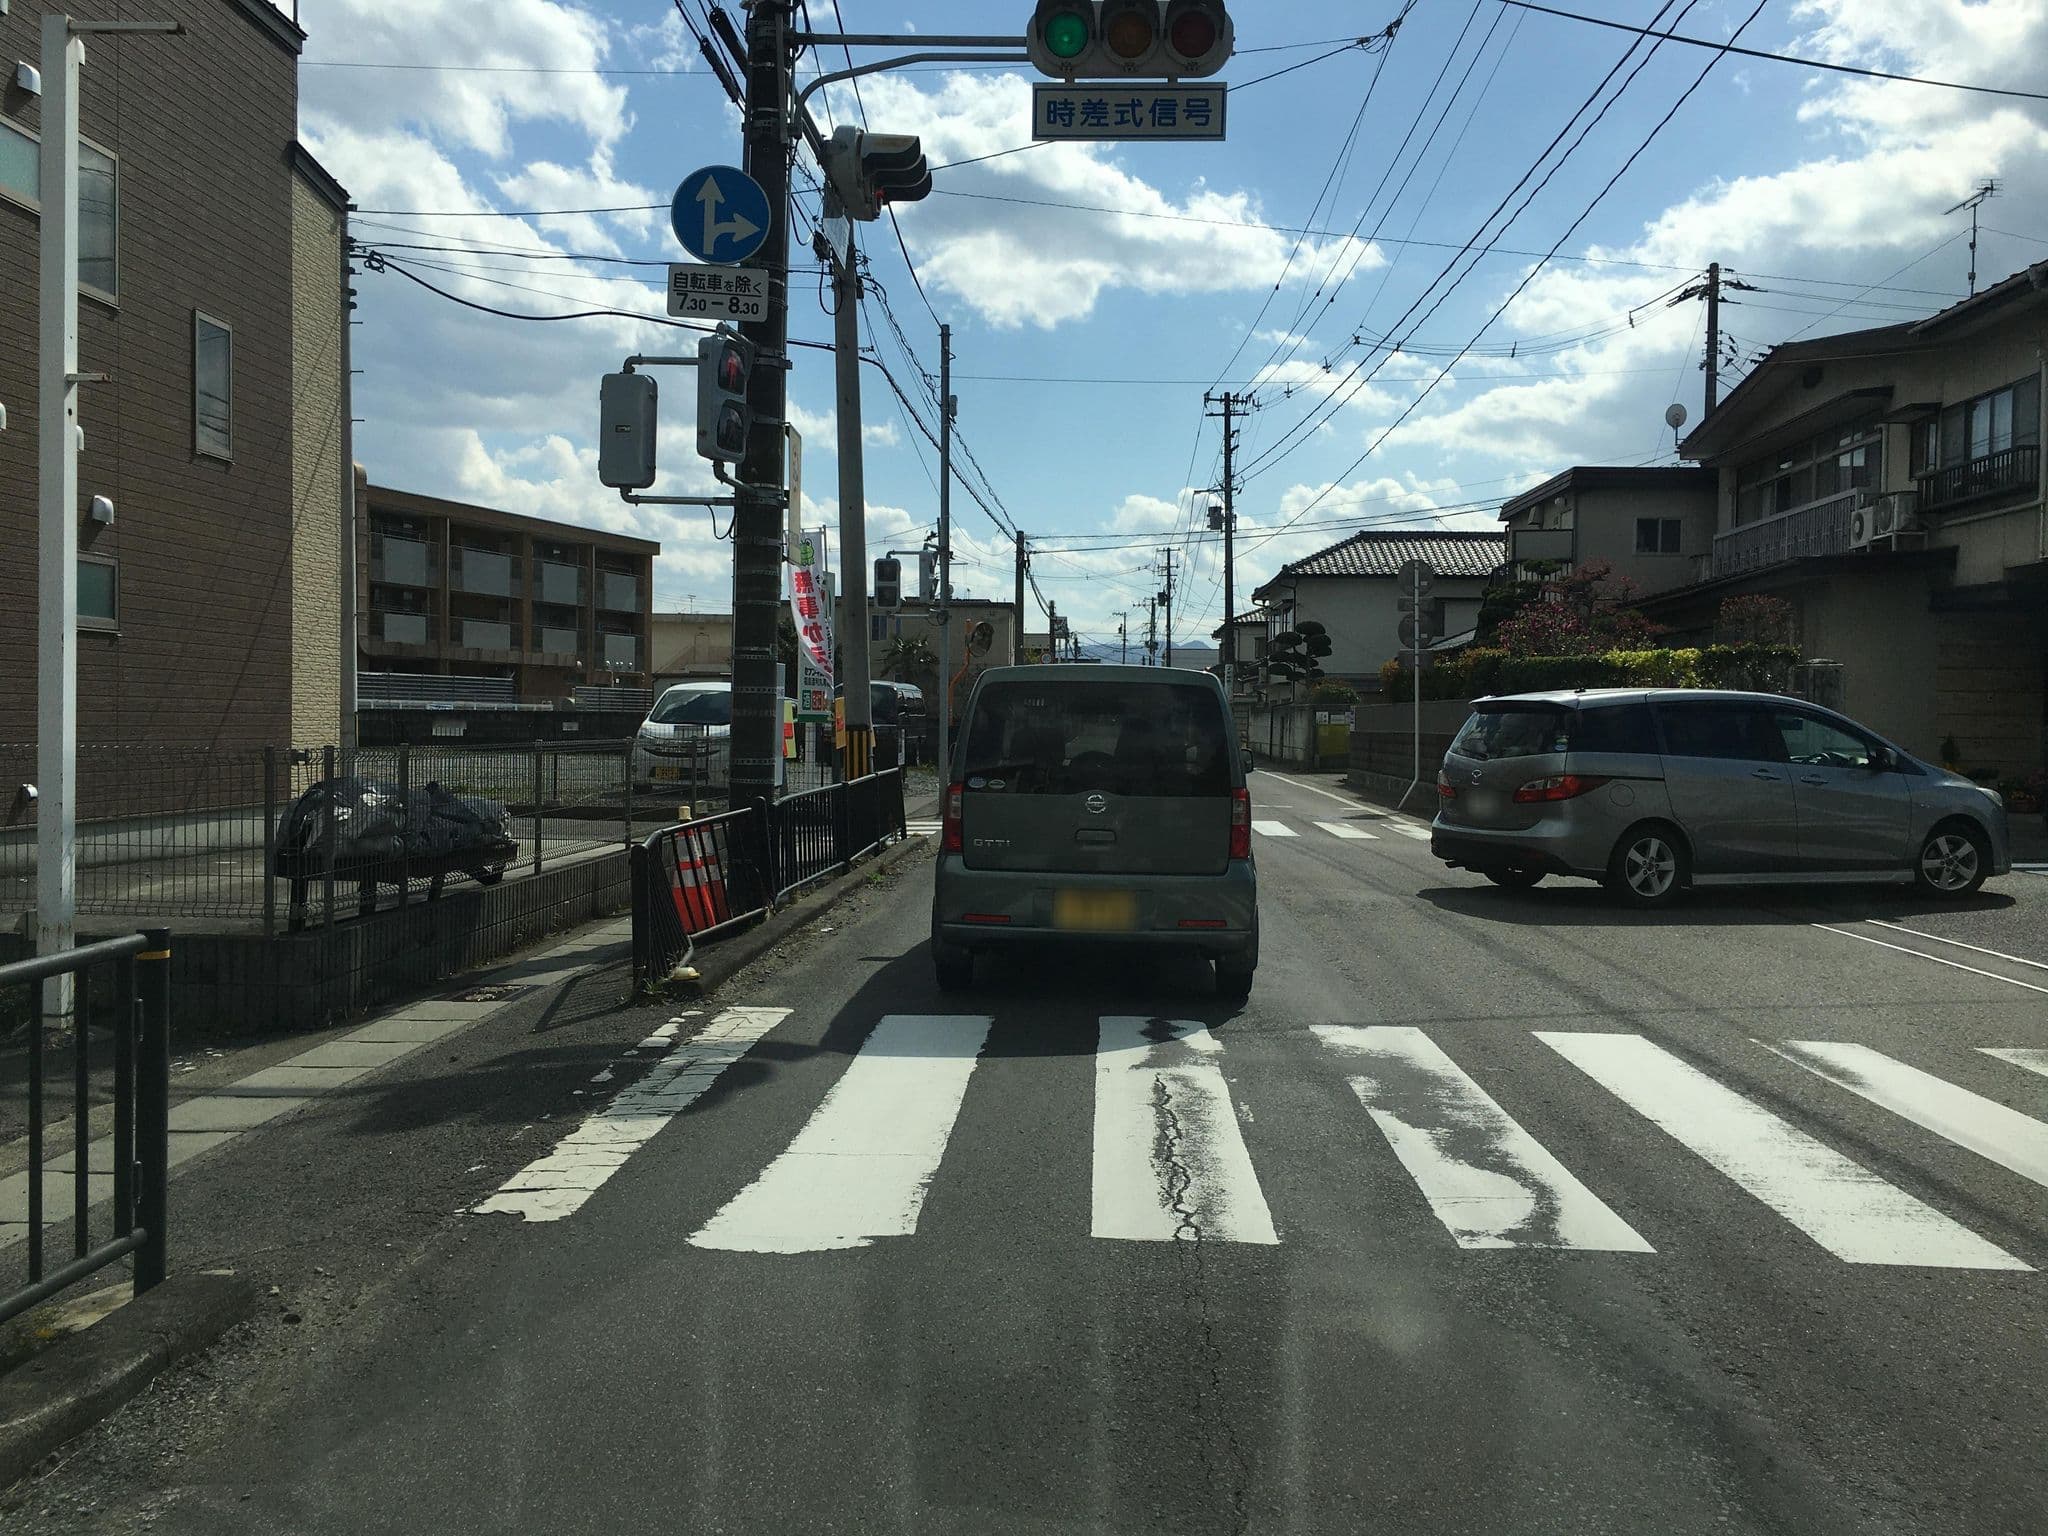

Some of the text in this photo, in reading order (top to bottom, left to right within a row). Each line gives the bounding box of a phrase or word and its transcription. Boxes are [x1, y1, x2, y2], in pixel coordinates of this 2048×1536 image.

[1045, 97, 1213, 128] 時差式信号
[673, 271, 762, 294] 自転車を除く
